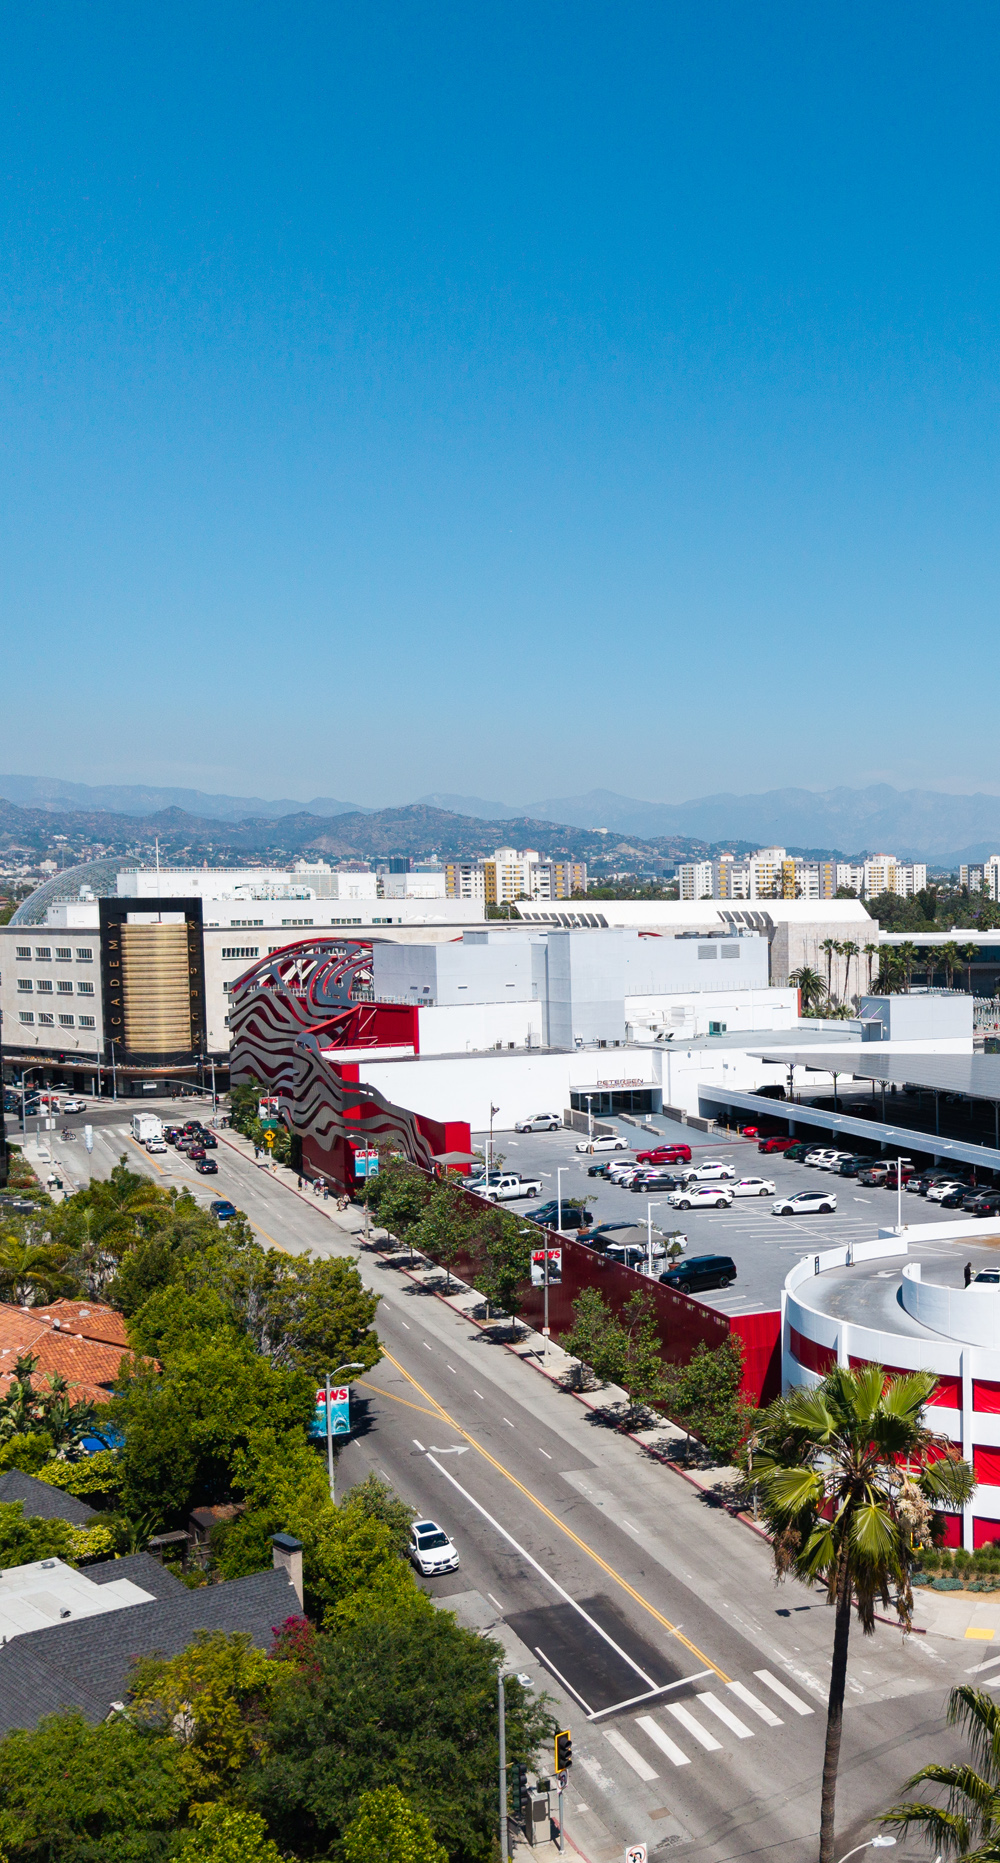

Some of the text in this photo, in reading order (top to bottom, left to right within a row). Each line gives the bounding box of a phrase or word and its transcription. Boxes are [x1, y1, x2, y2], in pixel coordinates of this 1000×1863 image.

[107, 921, 121, 1043] ACADEMY
[188, 920, 200, 1045] MUSEUM
[596, 1078, 644, 1087] PETERSEN
[532, 1250, 561, 1261] JAWS
[316, 1389, 348, 1403] AWS
